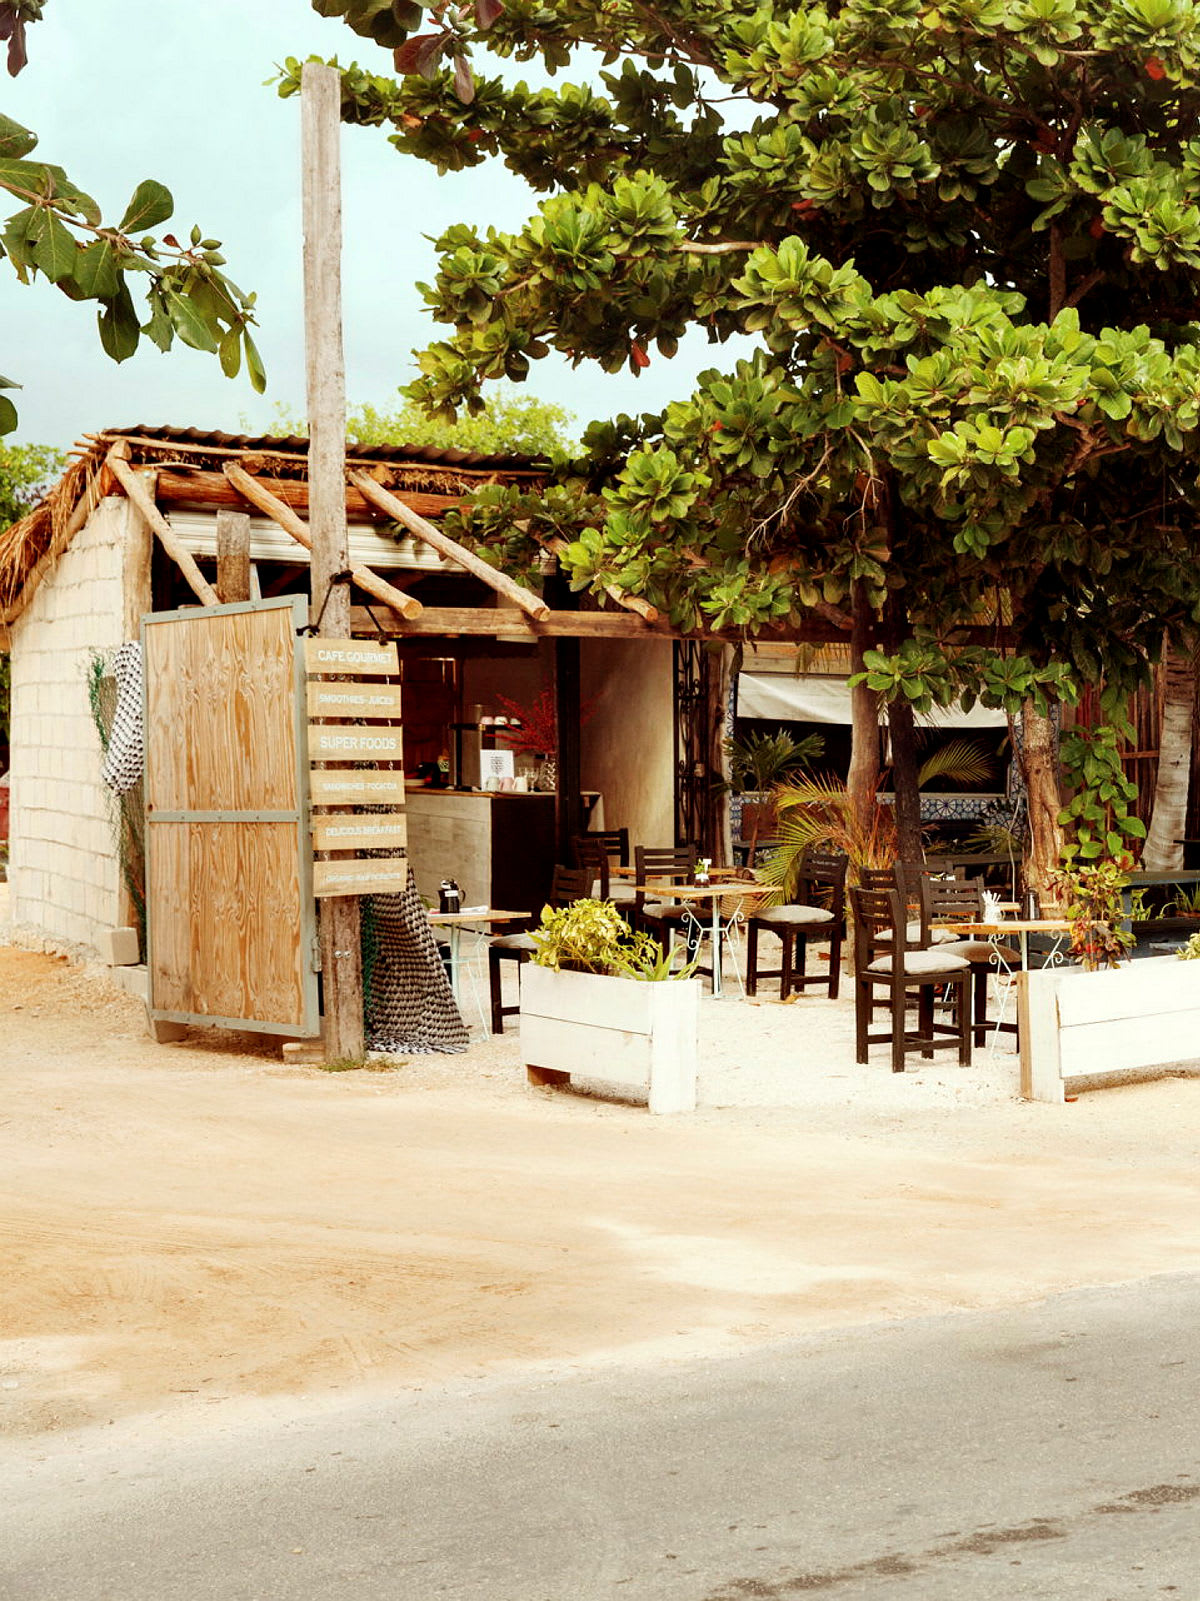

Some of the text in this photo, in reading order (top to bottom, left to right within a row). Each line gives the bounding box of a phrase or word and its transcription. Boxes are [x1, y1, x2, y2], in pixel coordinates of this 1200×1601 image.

[318, 650, 393, 665] CAFE GOURMET
[320, 736, 397, 750] SUPER FOODS
